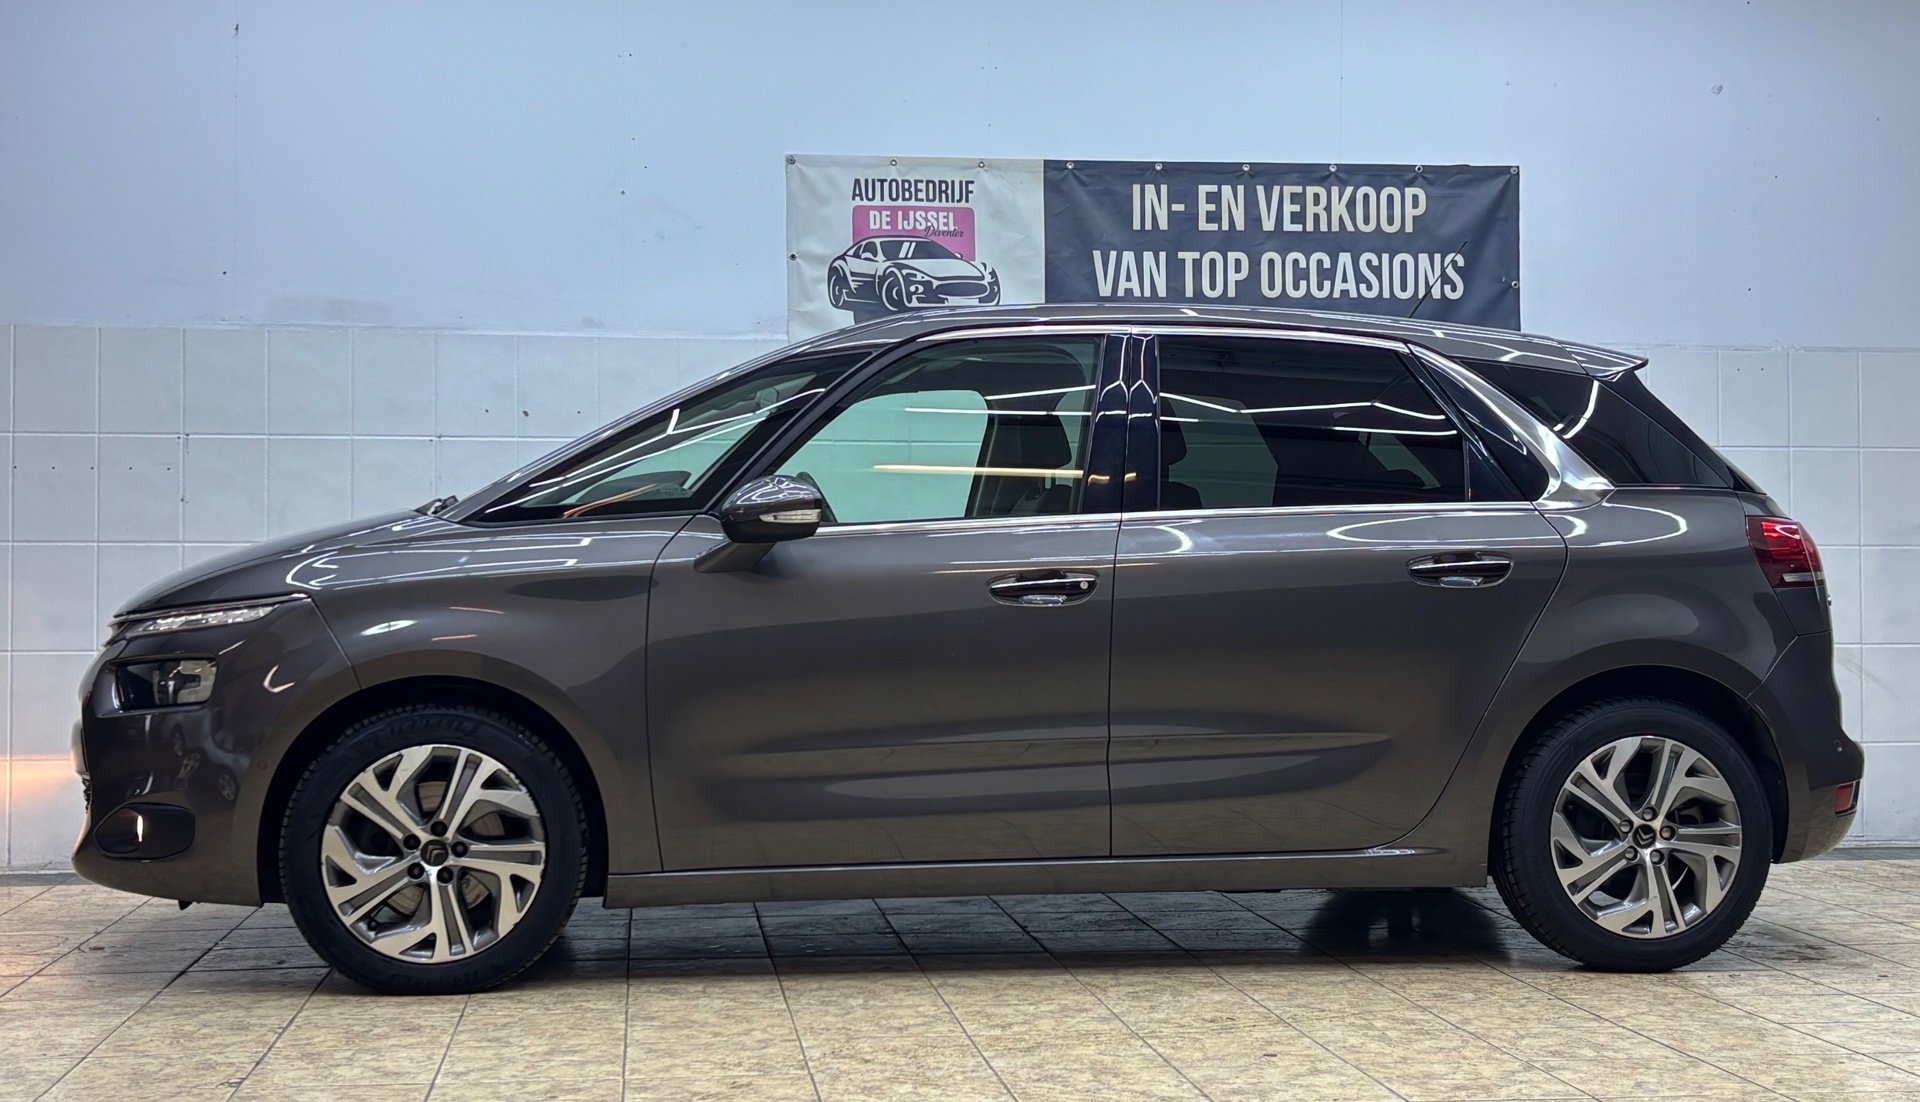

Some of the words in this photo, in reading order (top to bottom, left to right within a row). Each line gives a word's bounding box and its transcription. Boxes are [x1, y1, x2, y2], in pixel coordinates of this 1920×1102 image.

[851, 178, 975, 203] AUTOBEDRIJF
[869, 210, 891, 230] DE
[897, 210, 957, 231] IJSSEL
[1132, 184, 1185, 231] IN-
[1198, 184, 1245, 231] EN
[1256, 185, 1427, 233] VERKOOP
[924, 225, 964, 238] Deventer
[1092, 250, 1167, 297] VAN
[1178, 251, 1249, 298] TOP
[1260, 251, 1465, 300] OCCASIONS
